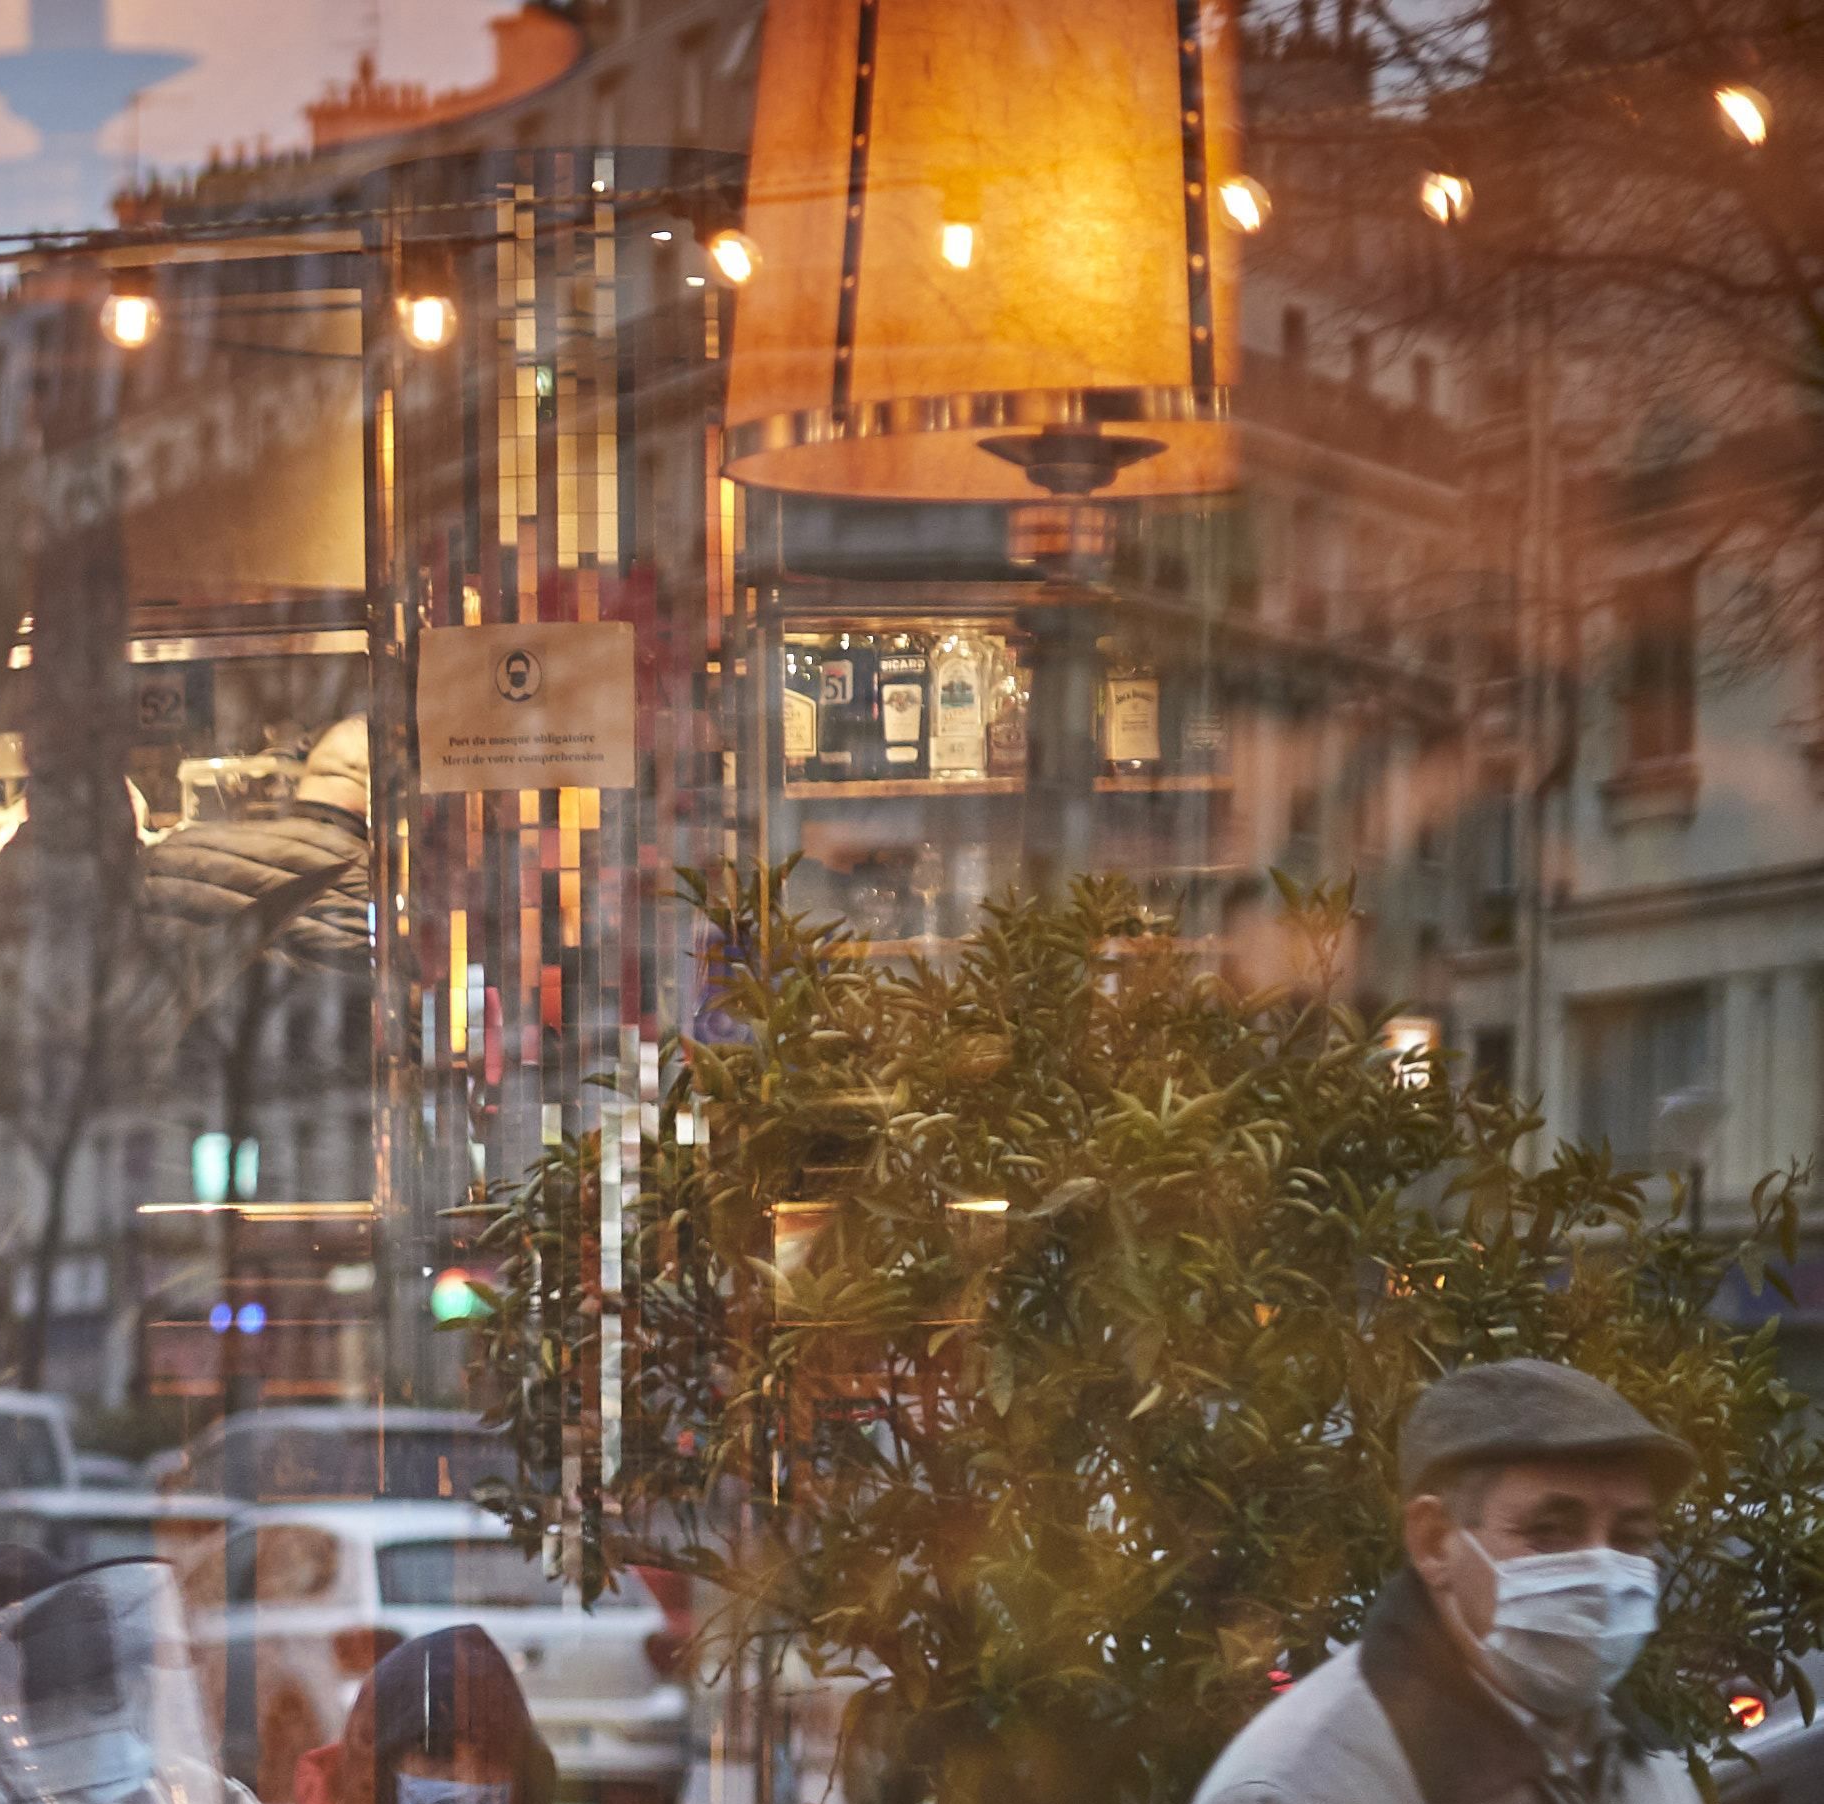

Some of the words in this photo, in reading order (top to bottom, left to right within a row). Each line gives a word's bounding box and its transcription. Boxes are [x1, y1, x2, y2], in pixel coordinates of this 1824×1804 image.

[880, 657, 926, 672] RICARD
[824, 674, 847, 701] 51
[449, 736, 469, 747] Port
[472, 735, 486, 746] du
[489, 736, 530, 747] masque
[533, 733, 595, 745] obligatoire
[442, 755, 470, 766] Merci
[472, 755, 485, 765] de
[487, 756, 514, 764] votre
